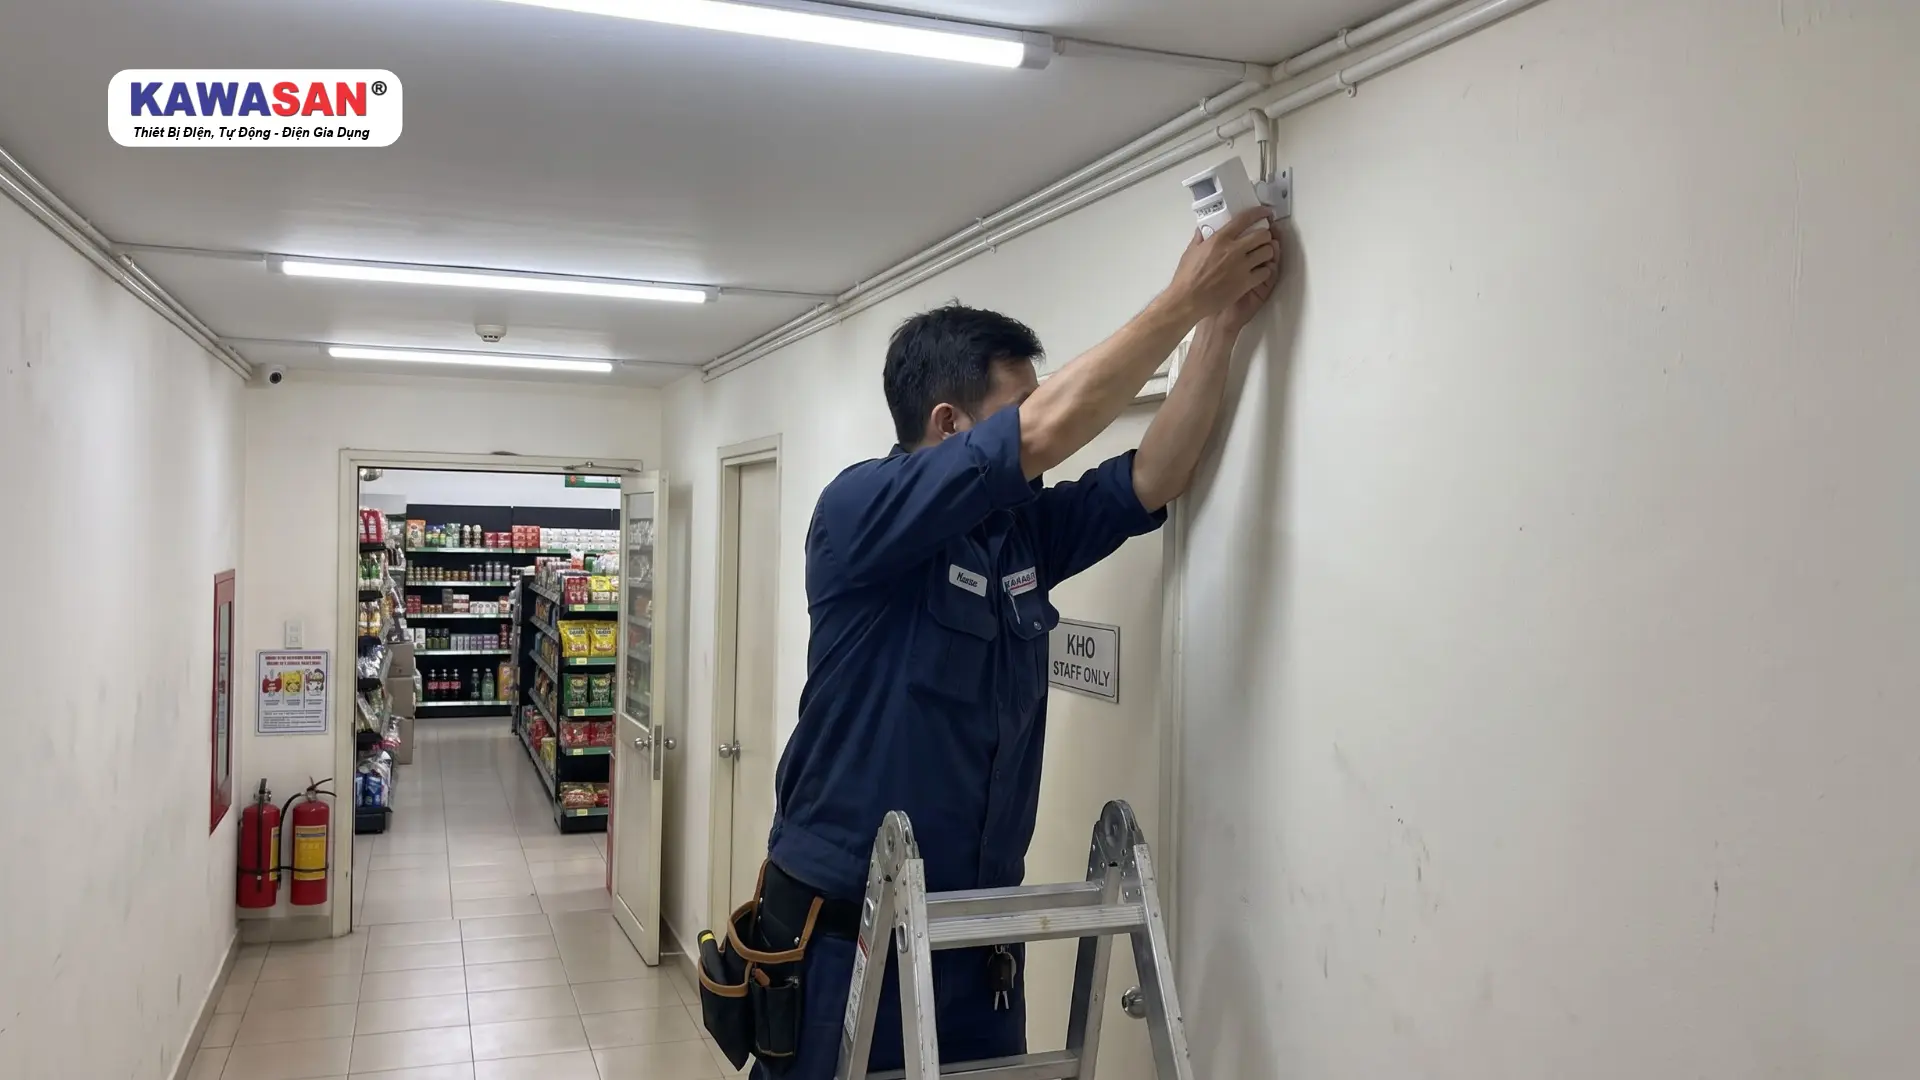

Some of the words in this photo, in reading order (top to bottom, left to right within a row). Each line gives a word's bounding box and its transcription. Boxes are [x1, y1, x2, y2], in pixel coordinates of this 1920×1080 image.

[1067, 633, 1096, 659] KHO
[1053, 660, 1082, 680] STAFF
[1083, 666, 1110, 687] ONLY
